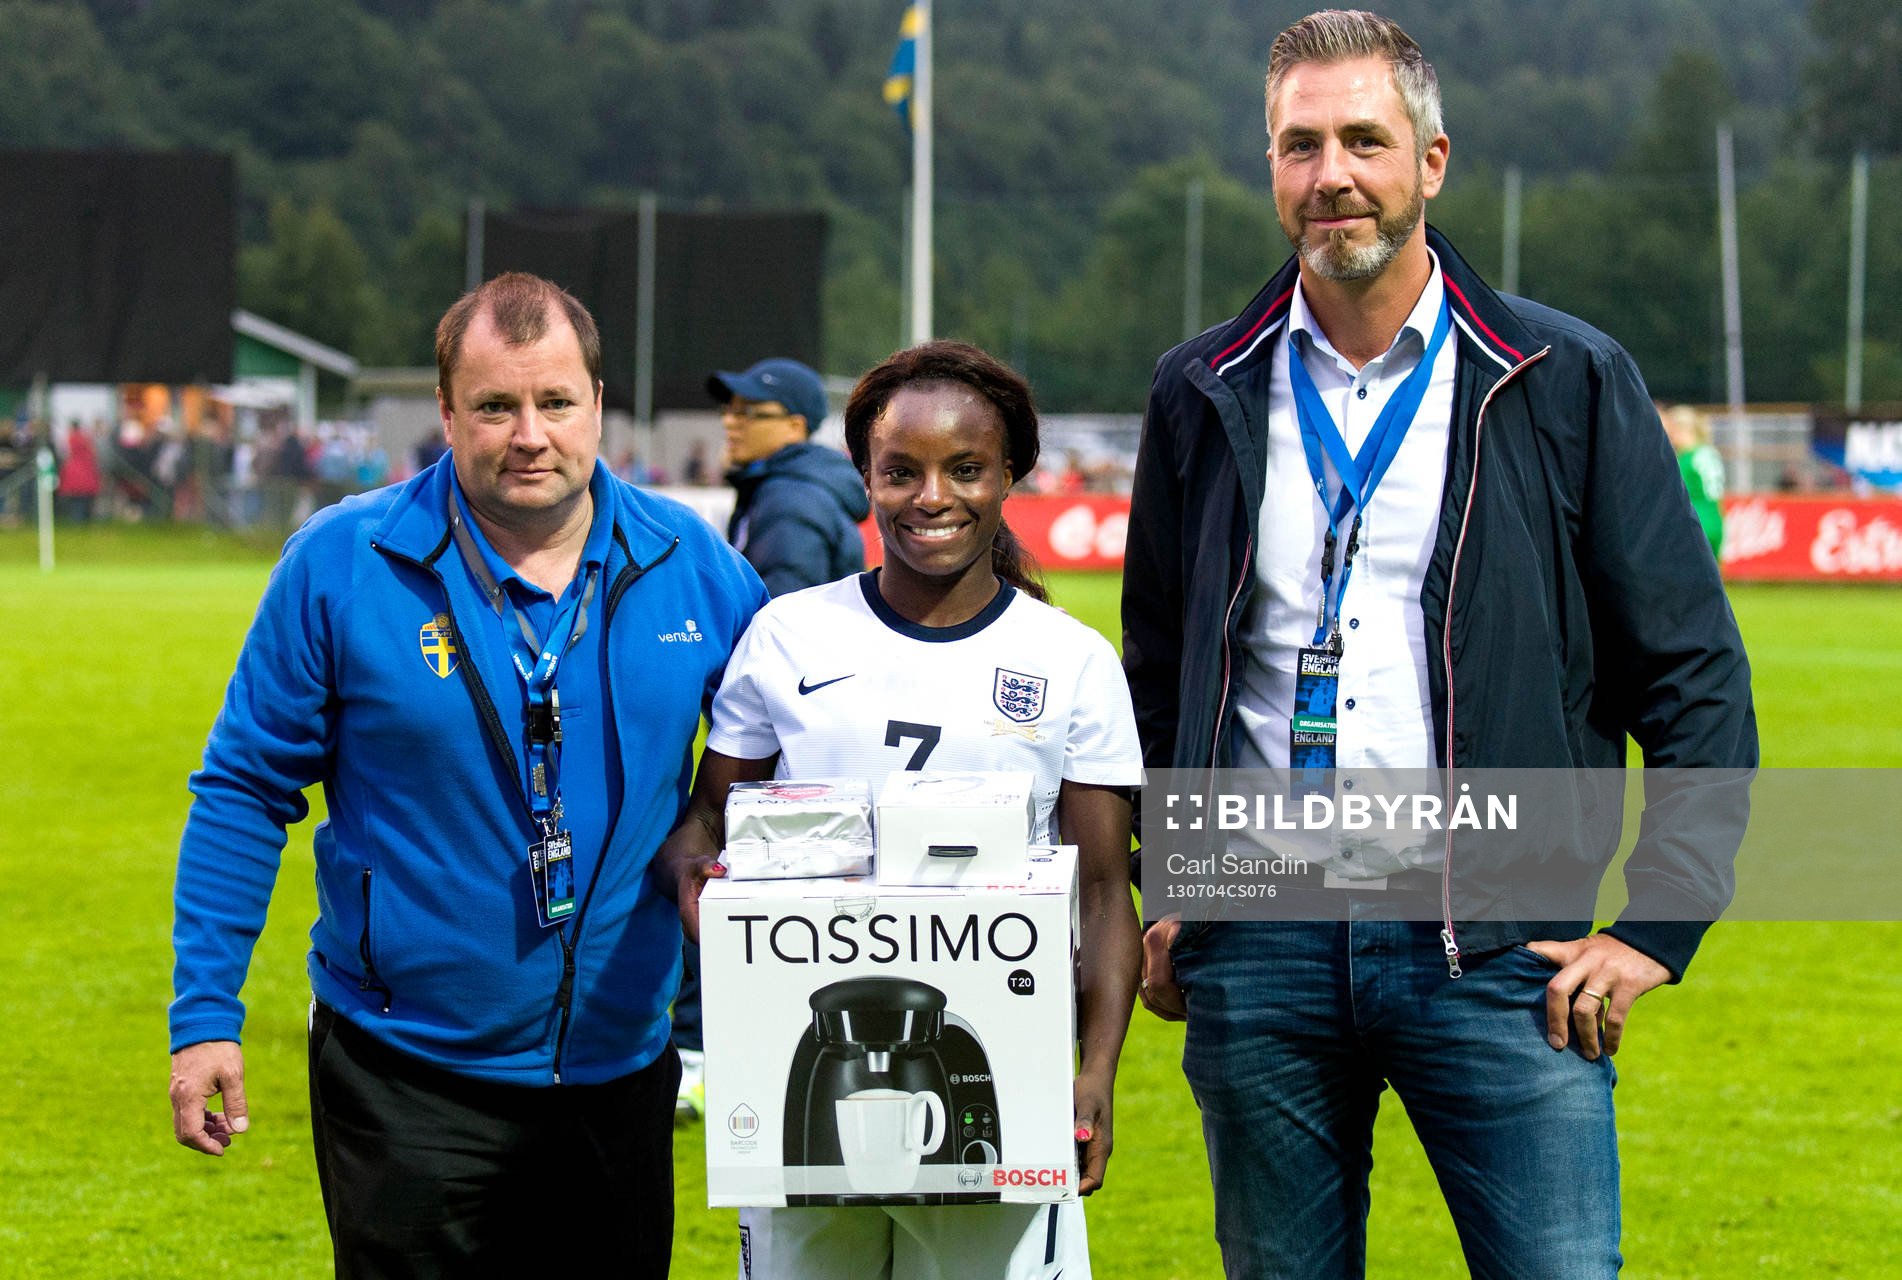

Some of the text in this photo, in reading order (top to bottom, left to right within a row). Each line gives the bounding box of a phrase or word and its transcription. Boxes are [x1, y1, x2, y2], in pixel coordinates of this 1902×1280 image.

[1301, 662, 1339, 674] ENGLAN
[1299, 720, 1337, 729] ORGANISATIO
[1294, 733, 1335, 743] ENGLAND
[884, 720, 942, 771] 7
[547, 846, 571, 859] ENGLAND
[962, 1074, 992, 1083] BOSCH
[993, 1169, 1067, 1186] BOSCH
